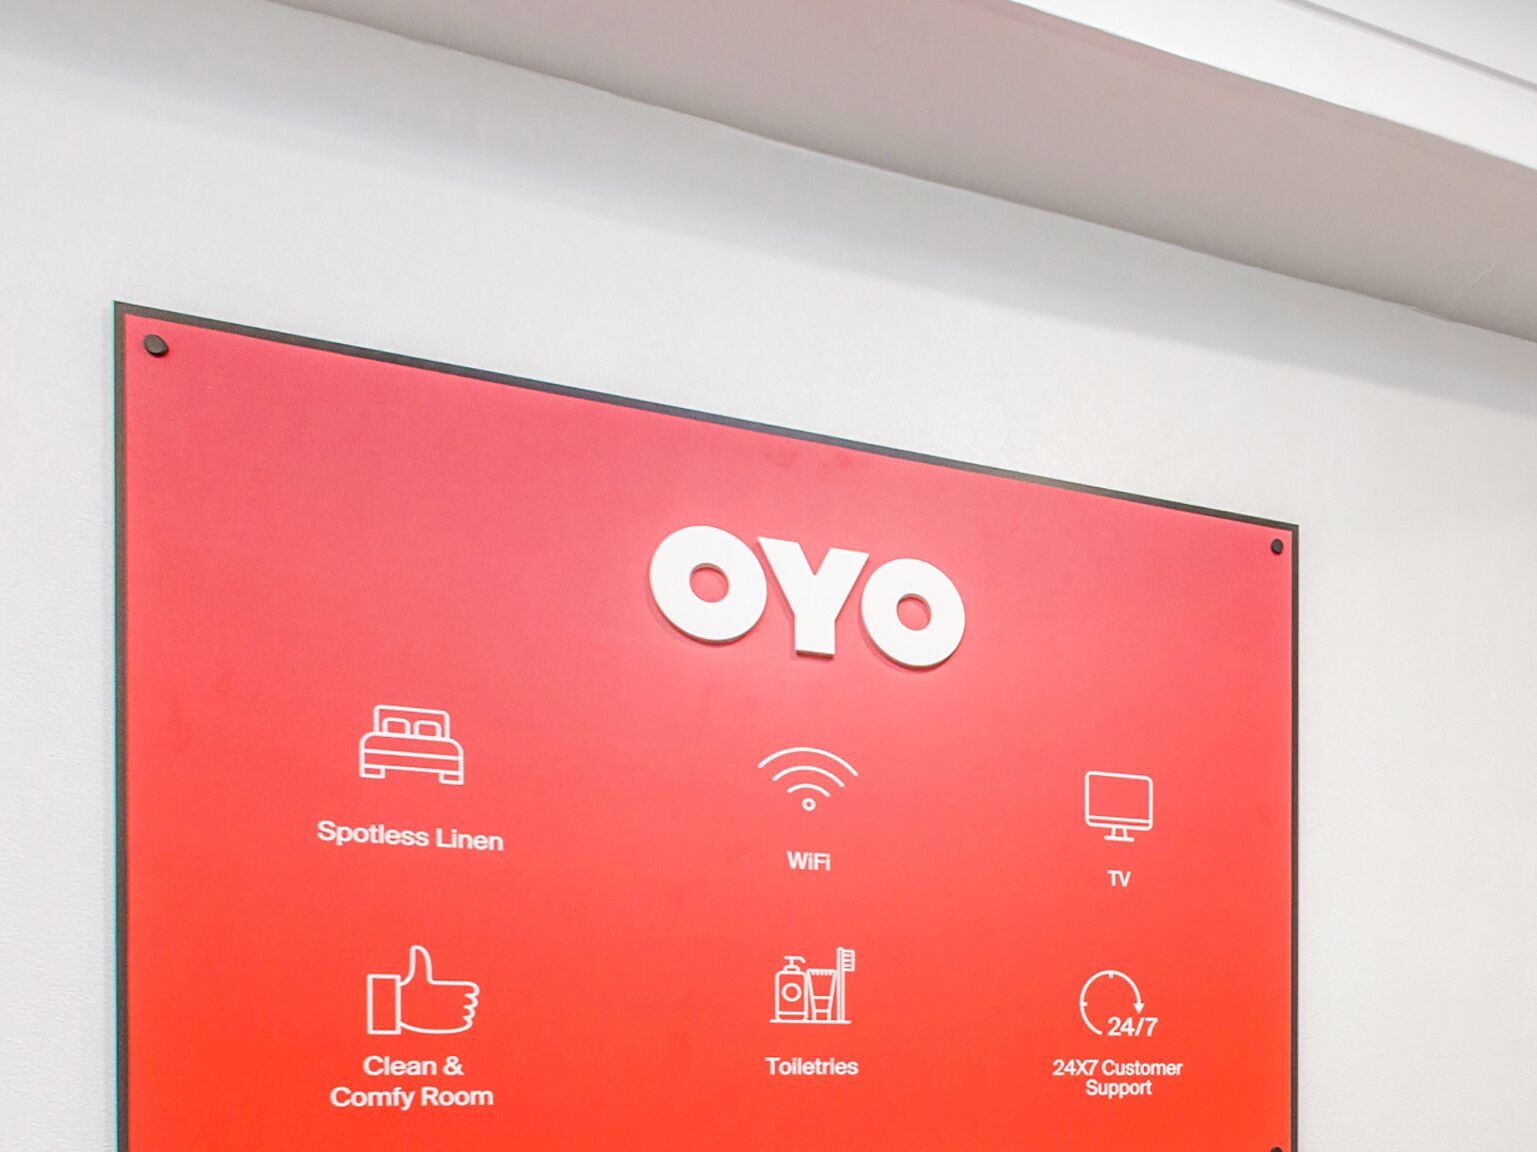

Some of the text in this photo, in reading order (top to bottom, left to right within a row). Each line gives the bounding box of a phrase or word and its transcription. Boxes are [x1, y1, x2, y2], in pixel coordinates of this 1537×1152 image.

[649, 525, 966, 668] OYO
[317, 820, 504, 852] Spotless Linen
[786, 851, 832, 872] WiFi
[1107, 869, 1132, 888] TV
[1107, 1016, 1159, 1037] 24/7
[364, 1056, 465, 1076] Clean &
[765, 1057, 859, 1076] Toiletries
[1052, 1059, 1184, 1076] 24X7 Customer
[331, 1087, 494, 1111] Comfy Room
[1085, 1079, 1153, 1099] Support
